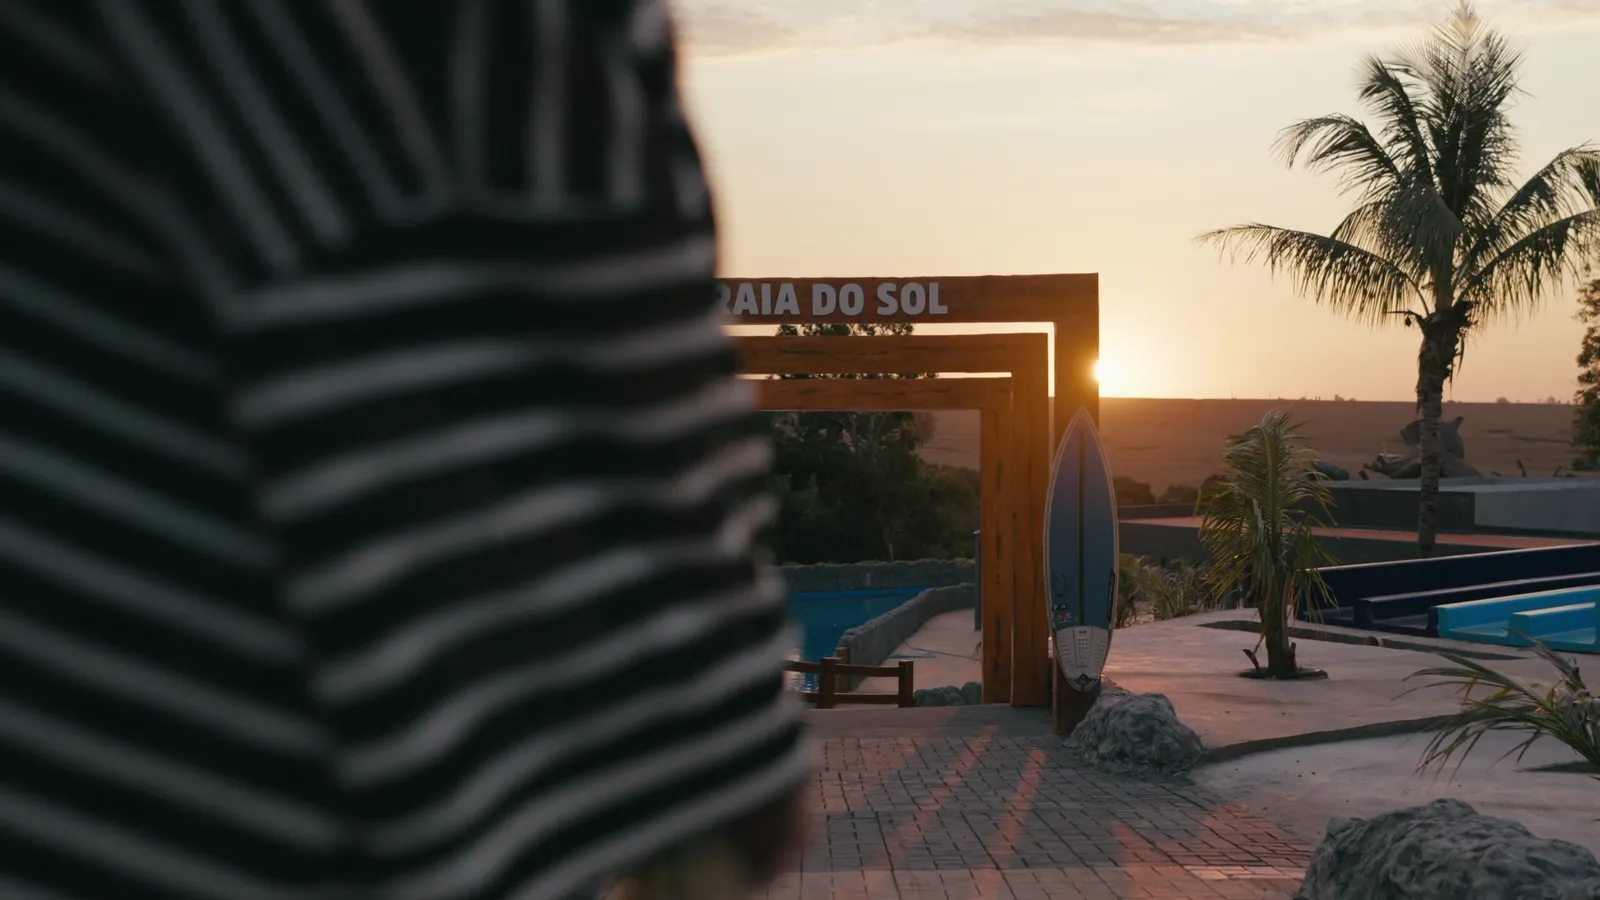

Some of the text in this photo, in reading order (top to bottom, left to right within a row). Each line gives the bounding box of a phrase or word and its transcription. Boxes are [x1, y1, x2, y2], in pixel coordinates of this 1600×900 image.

[714, 282, 948, 316] RAIA DO SOL
